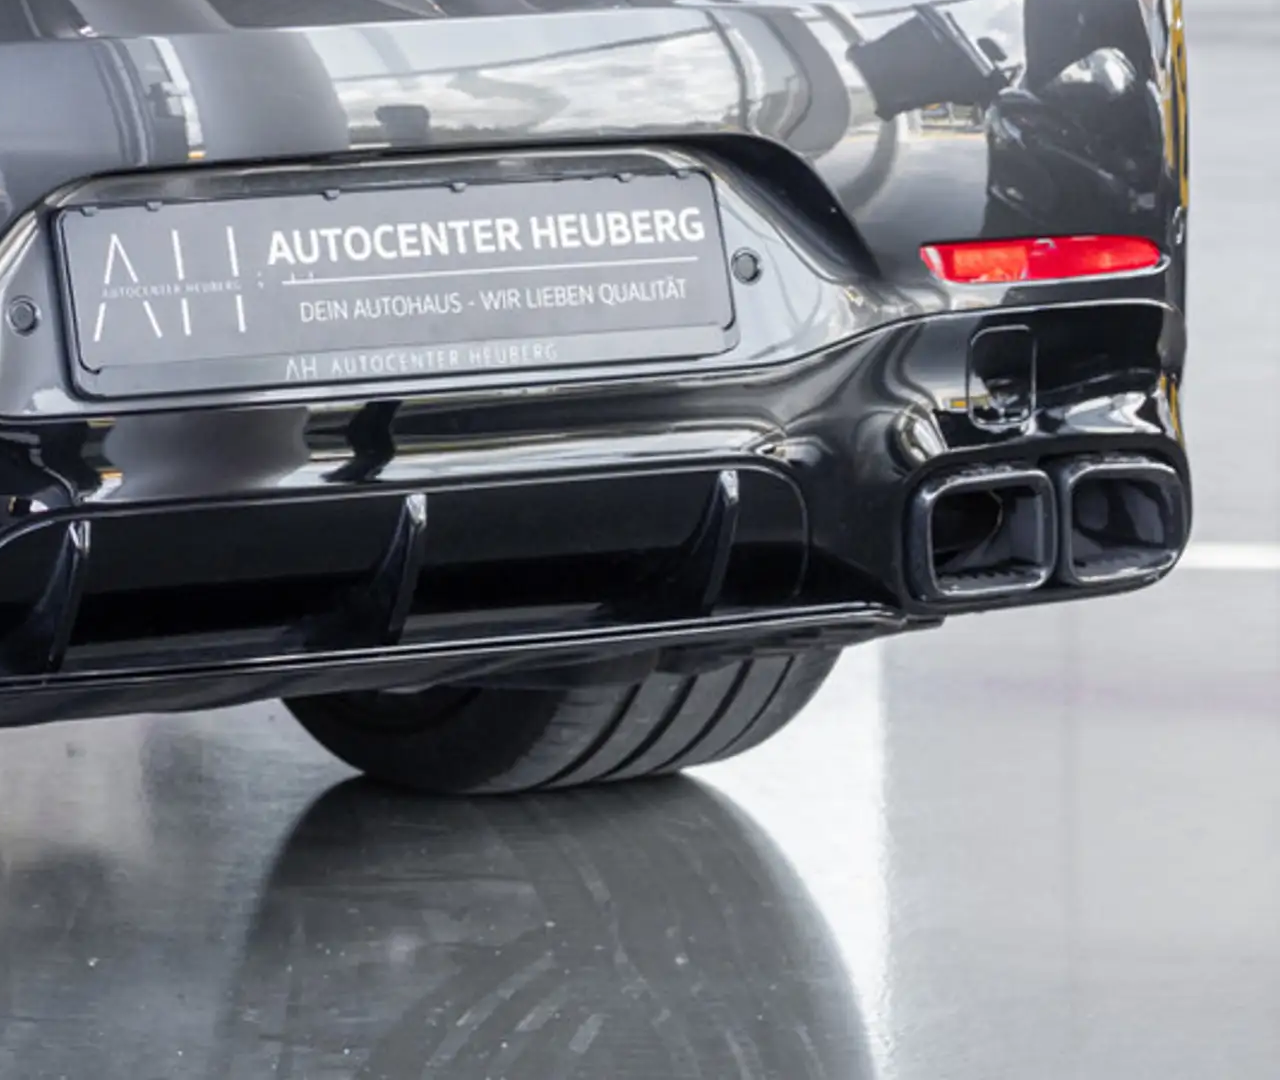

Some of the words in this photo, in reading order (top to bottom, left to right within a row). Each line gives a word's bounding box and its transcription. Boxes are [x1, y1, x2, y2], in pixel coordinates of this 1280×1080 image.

[268, 217, 521, 265] AUTOCENTER
[532, 207, 705, 251] HEUBERG
[93, 225, 246, 343] AH
[300, 296, 348, 322] DEIN
[354, 291, 463, 319] AUTOHAUS
[479, 286, 521, 312] WIR
[526, 283, 595, 309] LIEBEN
[598, 276, 687, 306] QUALITÄT
[285, 355, 318, 381] AH
[330, 349, 459, 380] AUTOCENTER
[468, 342, 558, 366] HEUBERG
